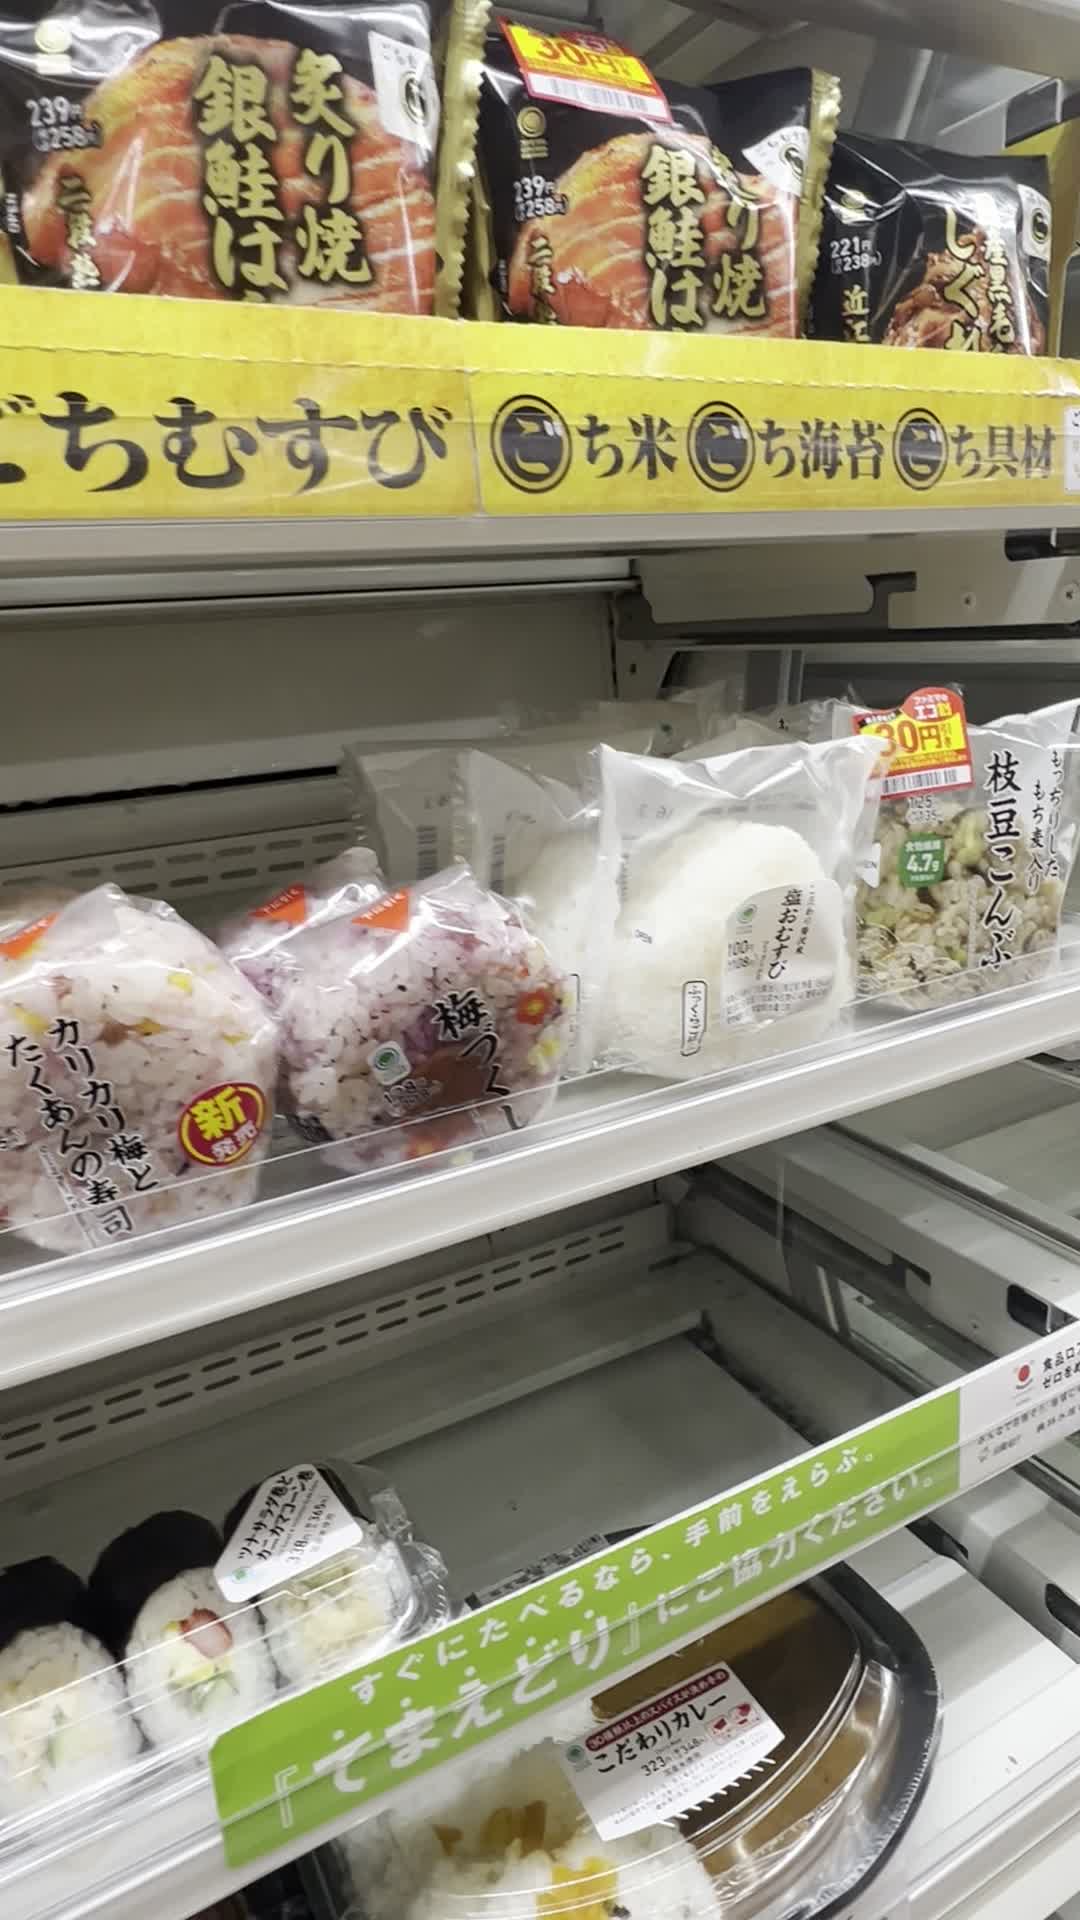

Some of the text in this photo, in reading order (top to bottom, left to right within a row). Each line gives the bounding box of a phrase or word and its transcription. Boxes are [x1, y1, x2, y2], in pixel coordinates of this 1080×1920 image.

[195, 55, 290, 303] 銀鮭は
[290, 48, 371, 284] 炙り焼
[643, 146, 705, 332] 銀鮭は
[906, 853, 940, 873] 4.7g
[980, 751, 1022, 970] 枝豆こんぶ
[1027, 779, 1047, 895] もち麦入り
[1046, 750, 1066, 878] もっちりした
[768, 888, 803, 979] 塩おむすび
[7, 1034, 133, 1236] たくあんの寿司
[50, 1018, 158, 1192] カリカリ梅と
[430, 989, 529, 1130] 梅づくし
[594, 1694, 727, 1773] こだわりカレー
